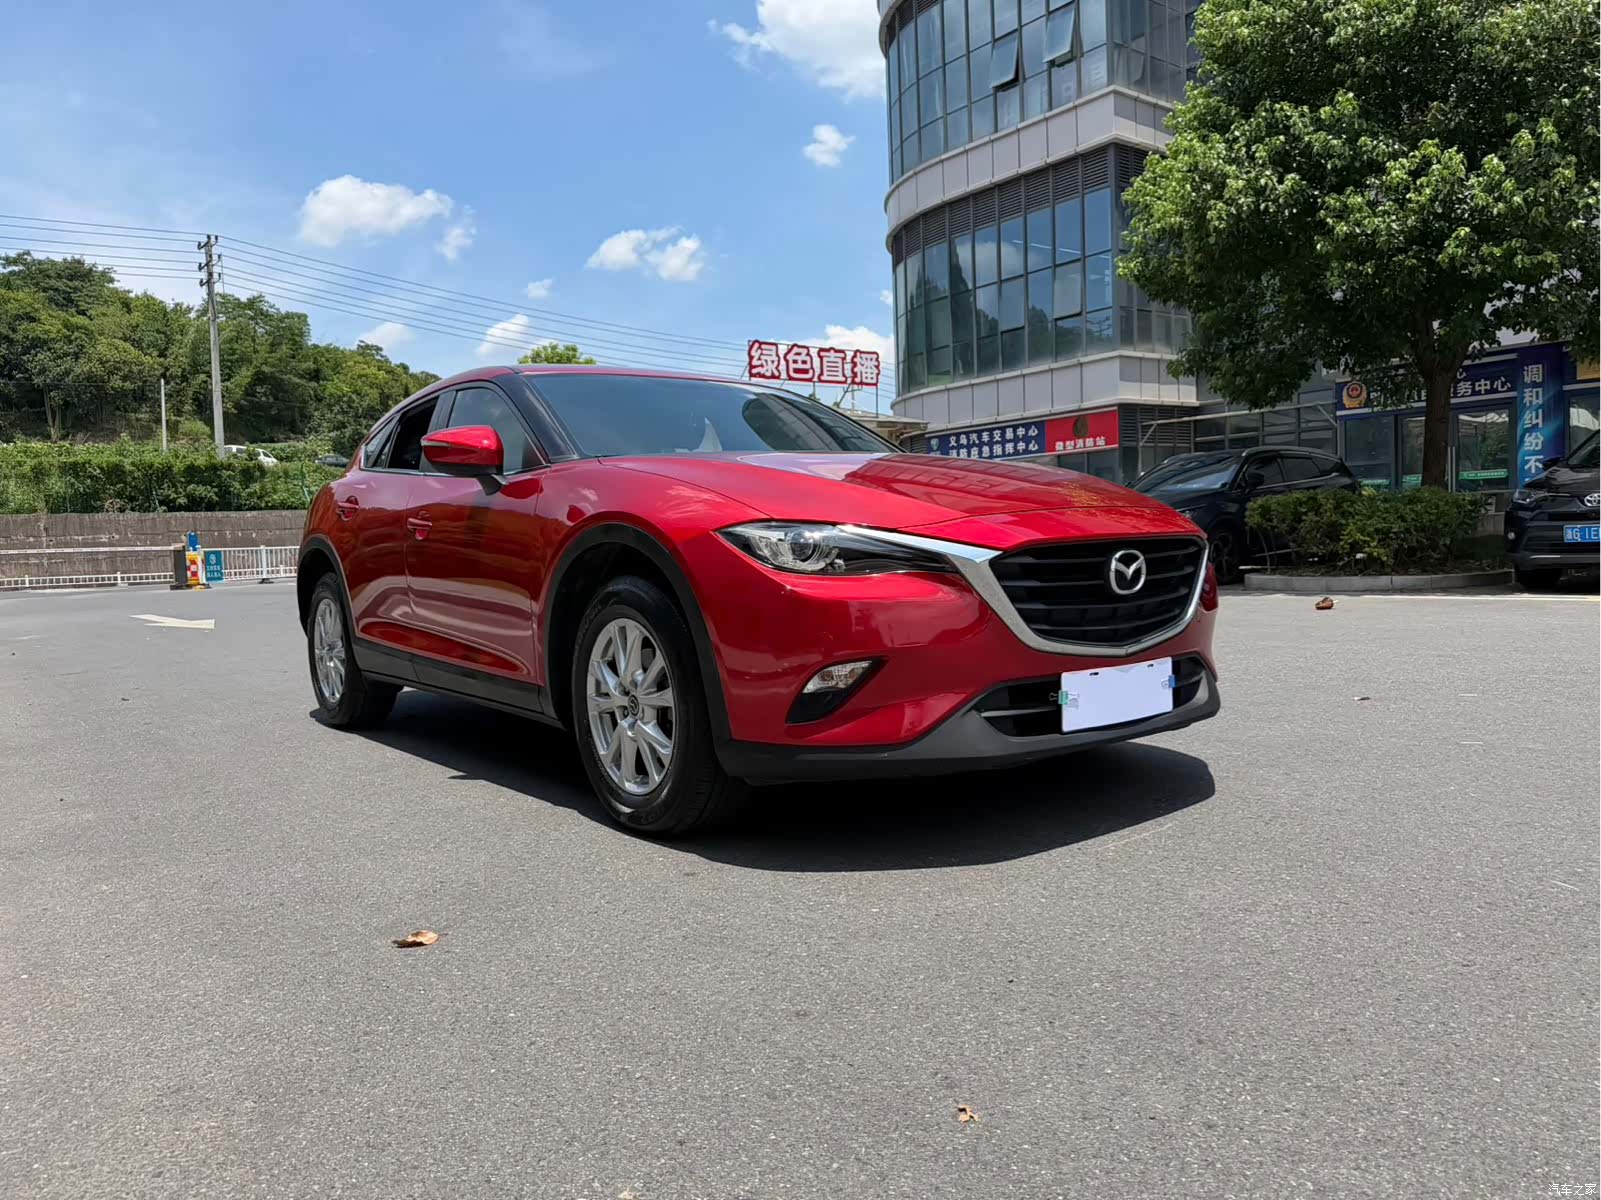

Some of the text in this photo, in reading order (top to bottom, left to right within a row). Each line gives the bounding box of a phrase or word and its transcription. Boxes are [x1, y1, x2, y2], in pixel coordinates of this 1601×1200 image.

[749, 341, 880, 384] 绿色直播
[949, 425, 1039, 447] 义乌汽车交易中心
[1523, 364, 1544, 481] 调和纠纷不
